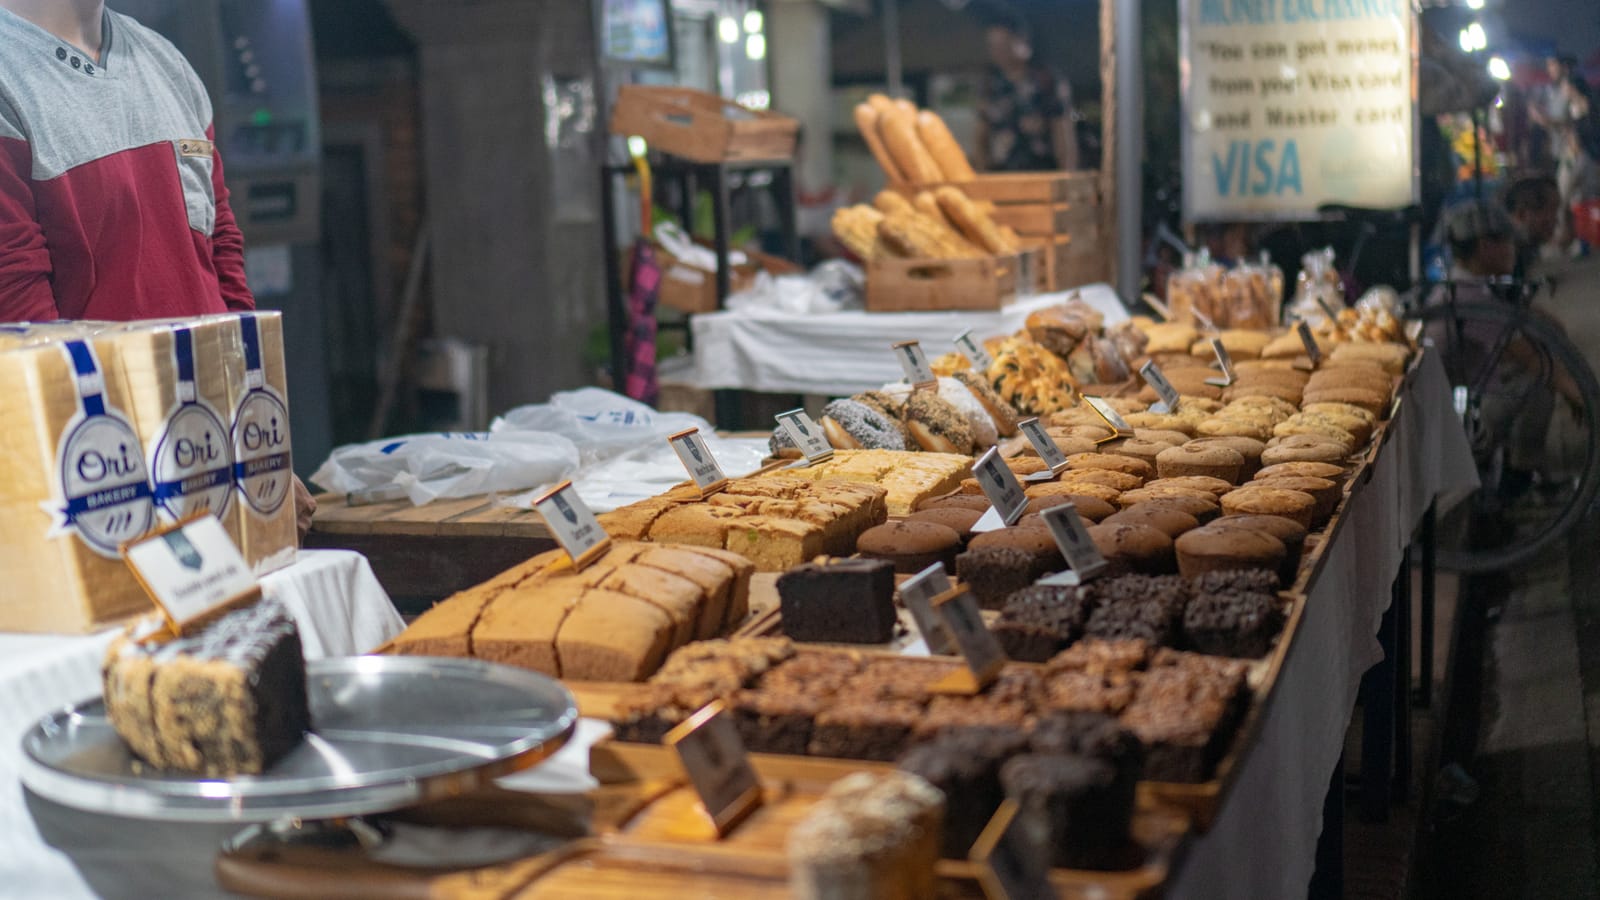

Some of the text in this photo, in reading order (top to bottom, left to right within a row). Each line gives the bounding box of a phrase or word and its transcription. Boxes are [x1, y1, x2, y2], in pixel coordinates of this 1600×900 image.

[1251, 42, 1288, 58] can
[1296, 38, 1328, 60] get
[1209, 75, 1255, 95] from
[1308, 70, 1352, 90] Visa
[1357, 68, 1402, 89] card
[1213, 106, 1402, 130] and Master card
[1211, 139, 1303, 197] VISA
[243, 416, 284, 451] Ori
[76, 442, 137, 483] Ori
[174, 430, 219, 469] Ori
[86, 485, 137, 509] BAKERY
